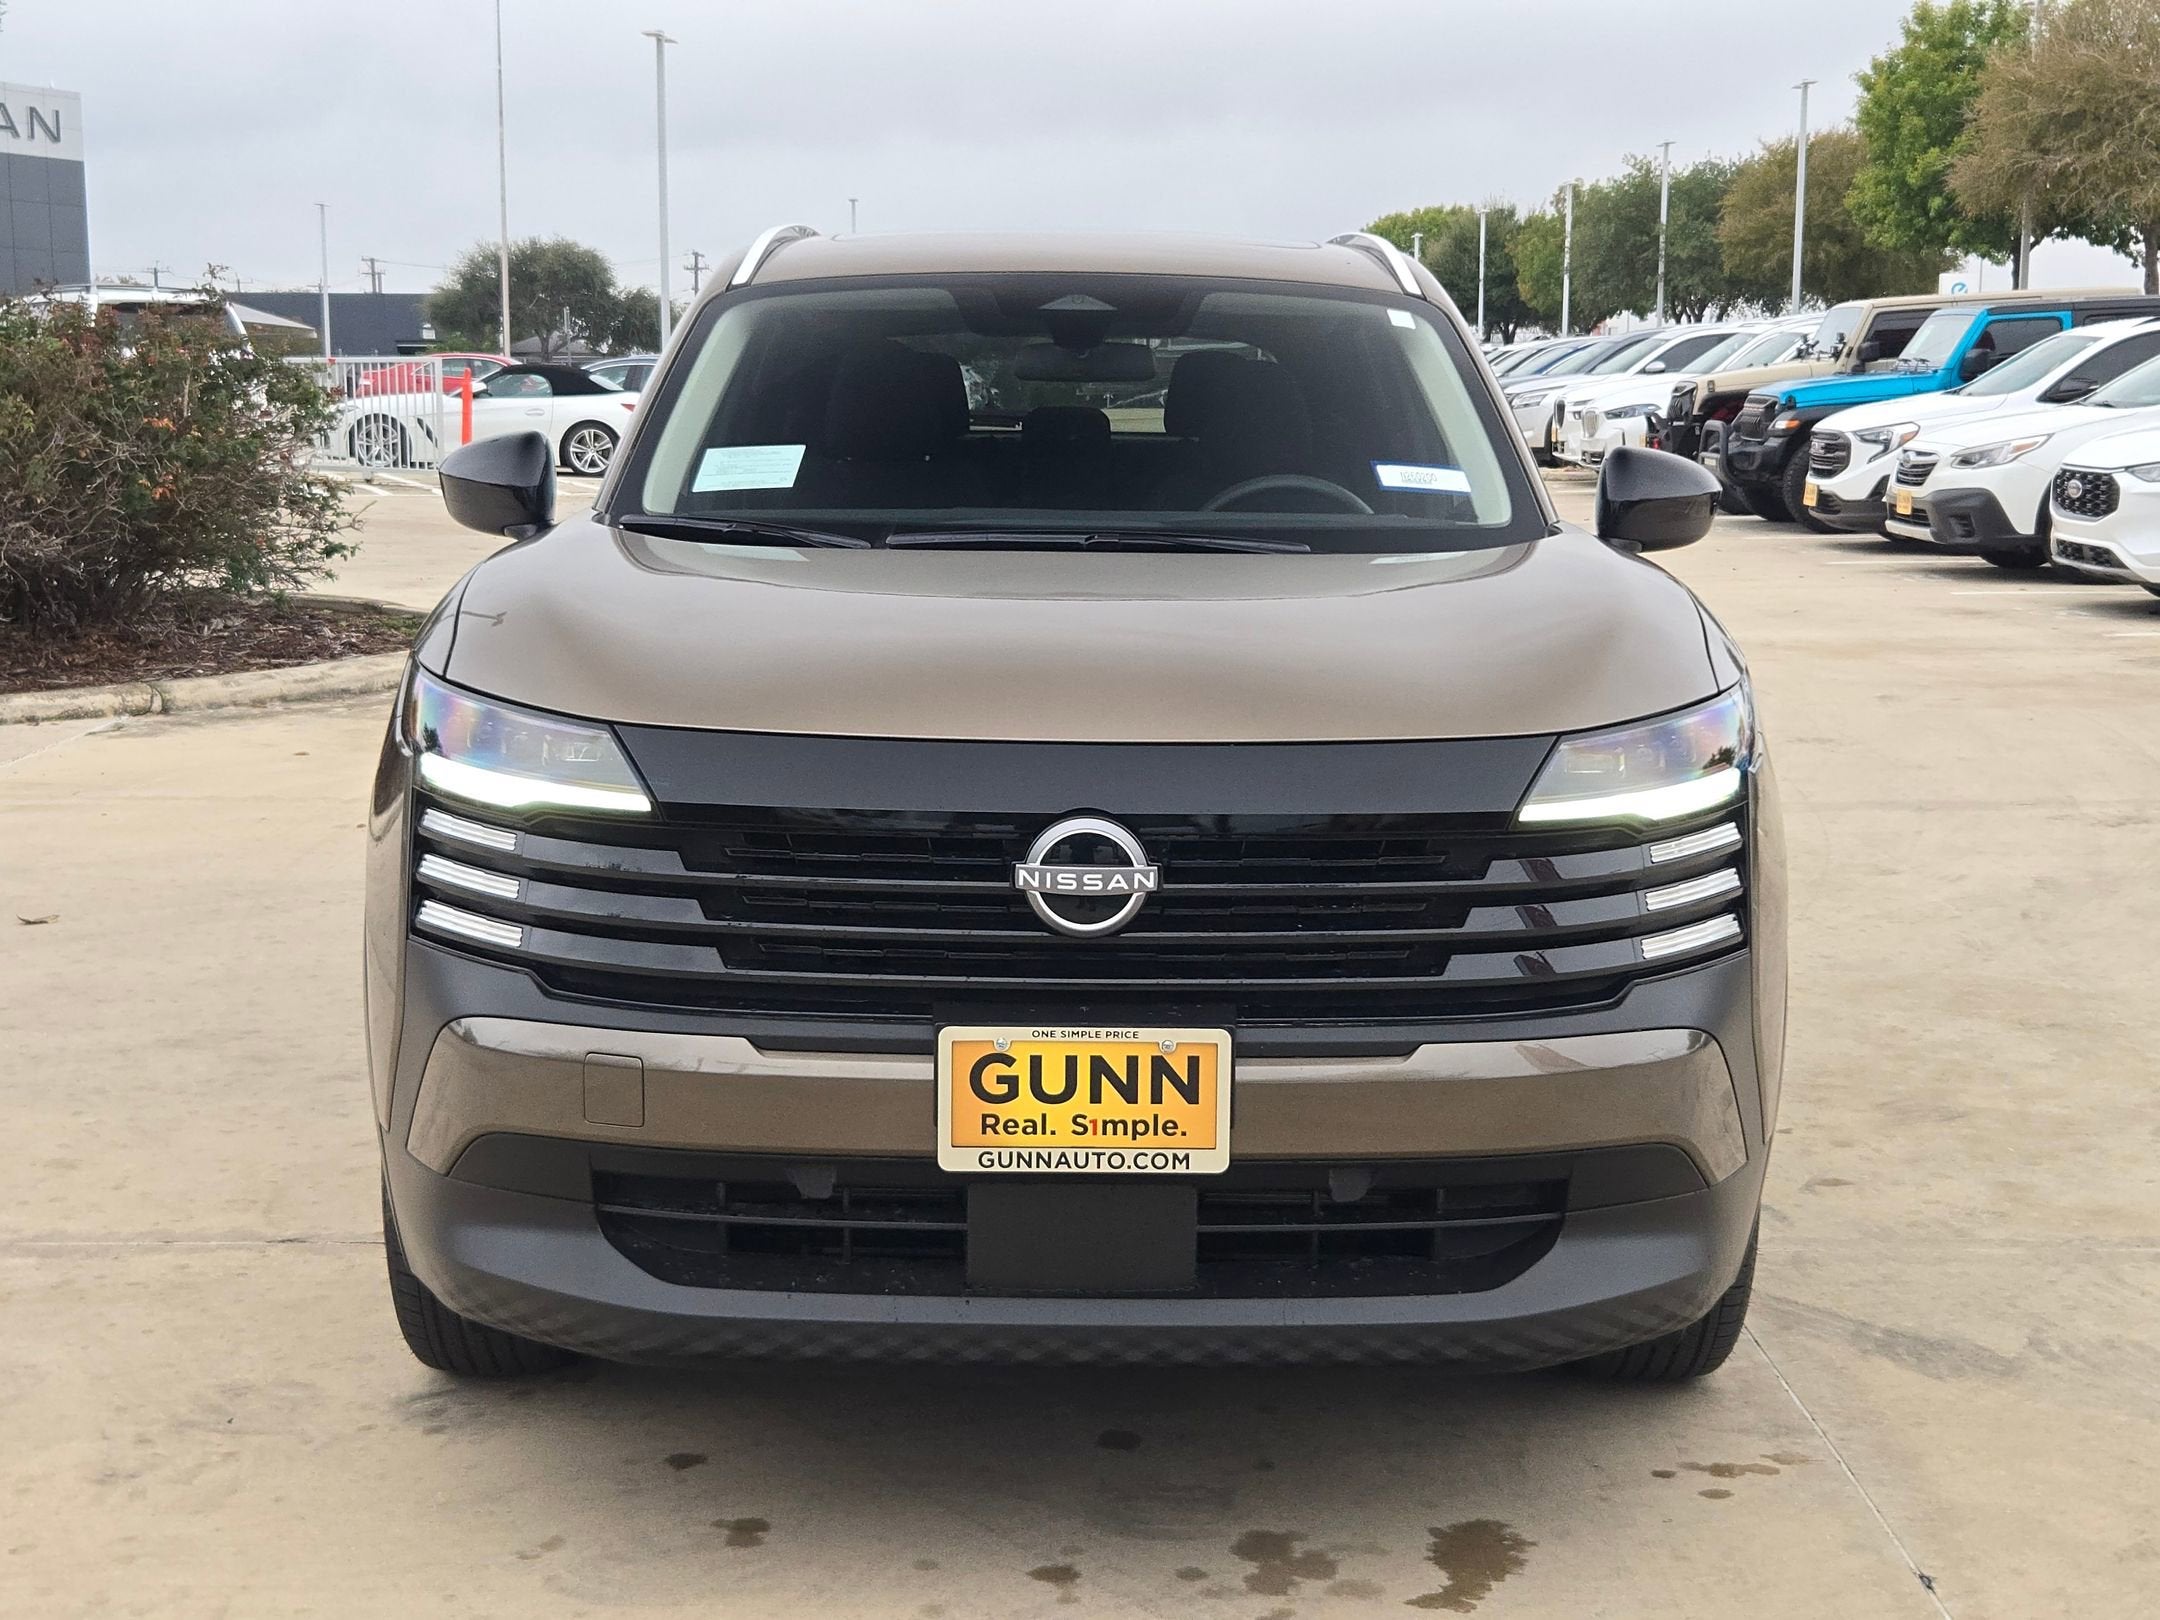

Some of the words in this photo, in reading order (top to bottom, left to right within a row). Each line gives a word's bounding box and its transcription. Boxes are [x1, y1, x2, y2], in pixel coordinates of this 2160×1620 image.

[1018, 869, 1155, 891] NISSAN
[1031, 1029, 1057, 1039] ONE
[1060, 1029, 1102, 1039] SIMPLE
[1105, 1030, 1140, 1039] PRICE
[968, 1052, 1201, 1105] GUNN
[980, 1112, 1057, 1136] Real.
[977, 1150, 1191, 1170] GUNNAUTO.COM
